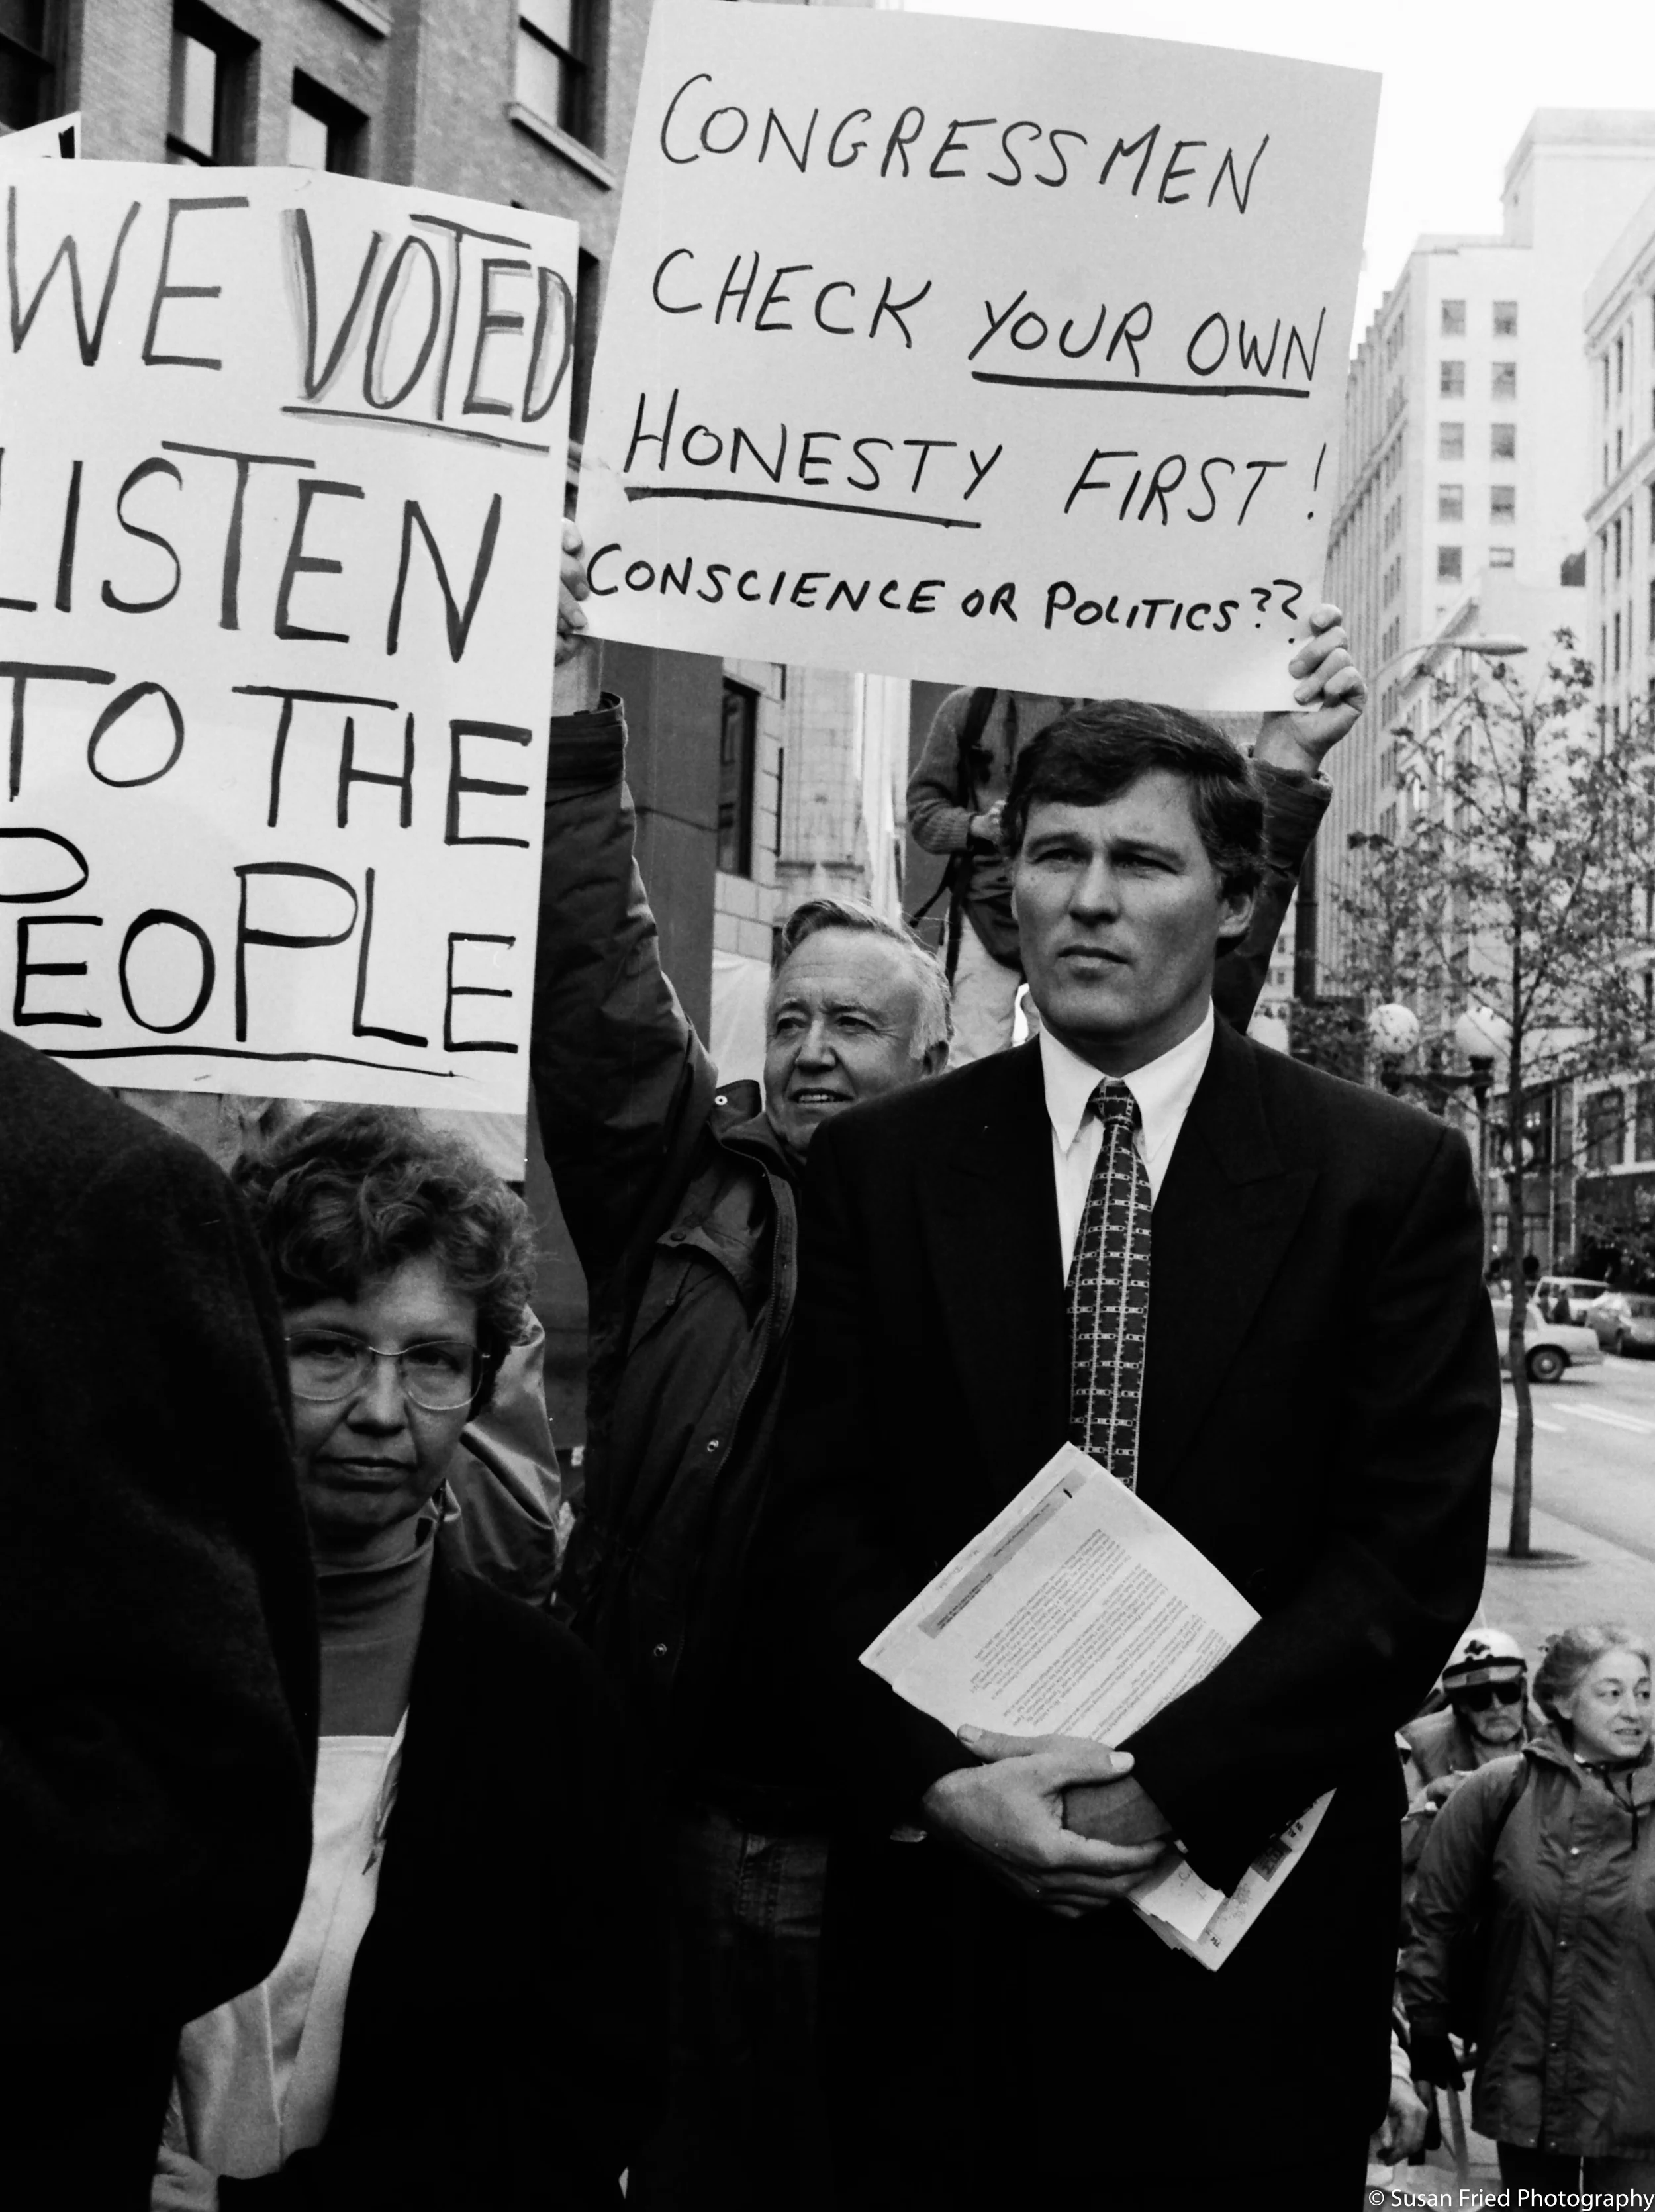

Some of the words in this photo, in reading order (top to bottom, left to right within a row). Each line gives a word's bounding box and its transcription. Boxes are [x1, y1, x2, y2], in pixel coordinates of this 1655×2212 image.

[661, 74, 1269, 214] CONGRESSMEN
[8, 186, 249, 367] WE
[281, 209, 575, 424] VOTED
[653, 249, 932, 348] CHECK
[968, 290, 1153, 377] YOUR
[1187, 307, 1326, 381] OWN
[624, 389, 1002, 500] HONESTY
[587, 543, 945, 614] CONSCIENCE
[961, 582, 1017, 622] OR
[0, 661, 184, 802] TO
[232, 685, 532, 848] THE
[0, 828, 518, 1053] PEOPLE
